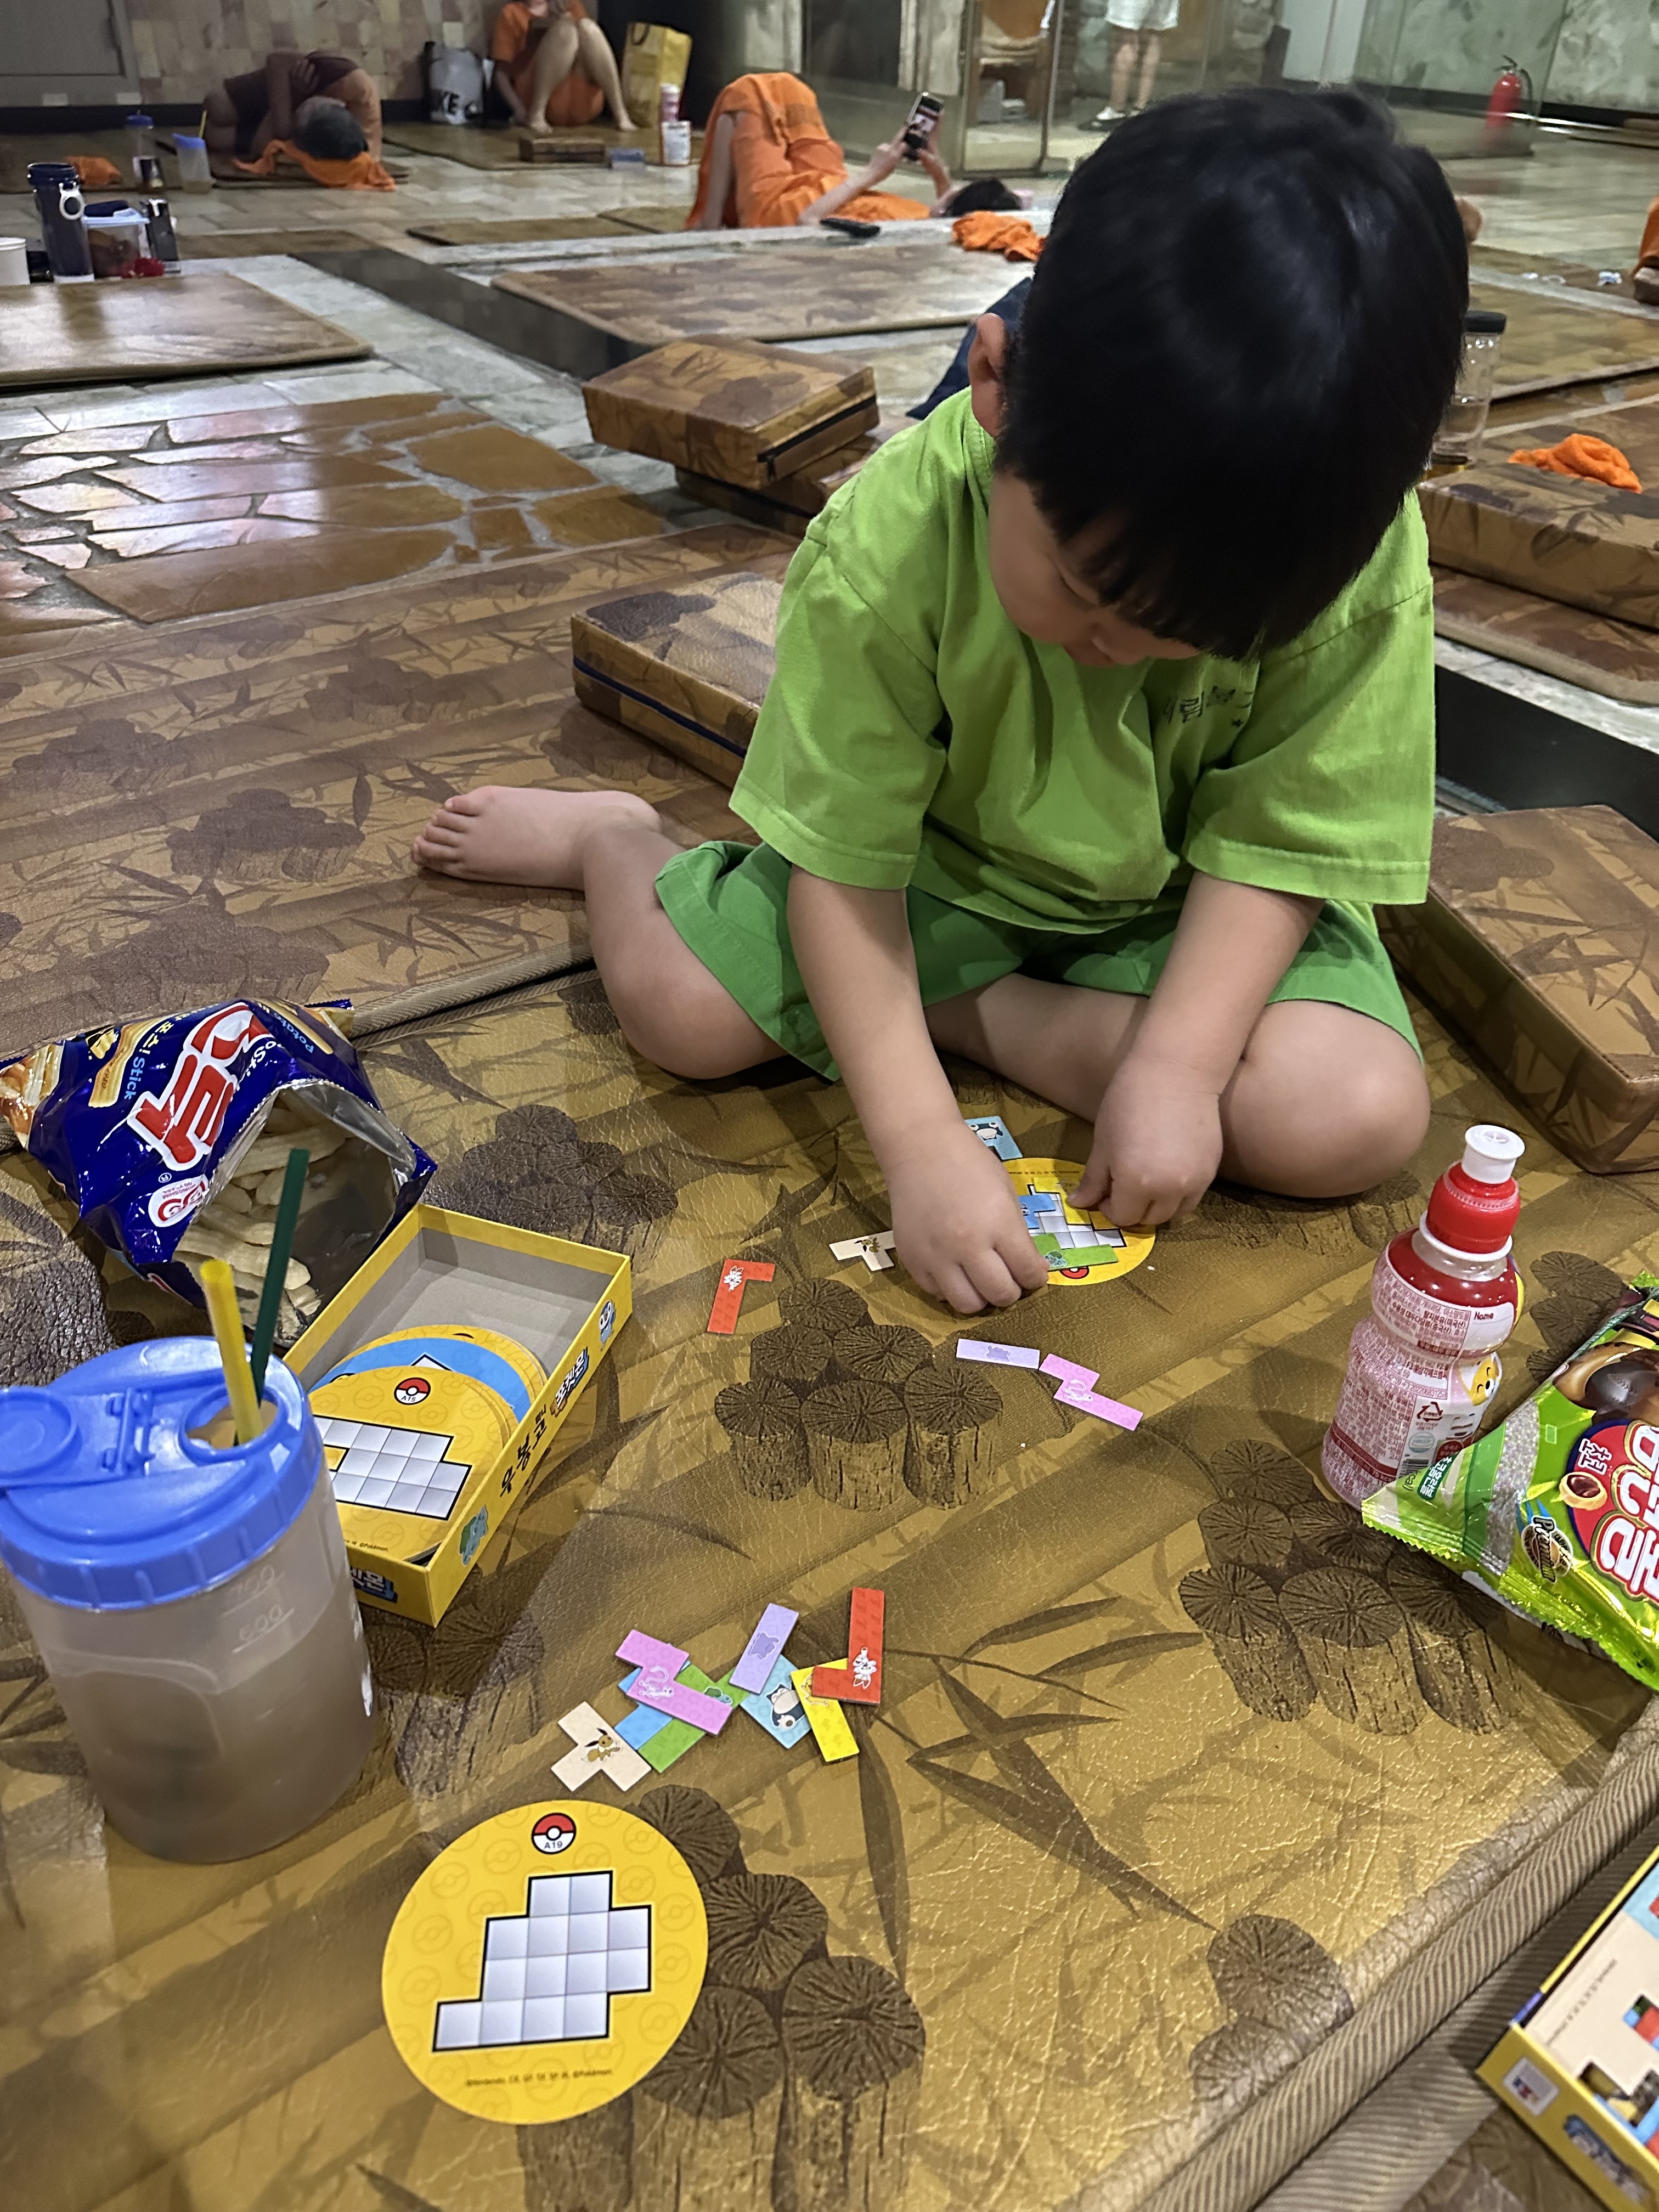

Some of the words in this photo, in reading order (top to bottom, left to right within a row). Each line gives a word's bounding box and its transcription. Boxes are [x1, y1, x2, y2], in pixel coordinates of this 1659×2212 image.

[273, 1012, 314, 1053] Potato
[101, 1069, 111, 1089] 1980
[125, 1056, 145, 1101] Stick
[1474, 1311, 1494, 1322] Name
[555, 1350, 585, 1409] 포켓몬
[499, 1418, 548, 1497] 우봉고
[1578, 1439, 1612, 1474] 초코
[544, 1839, 563, 1850] A19
